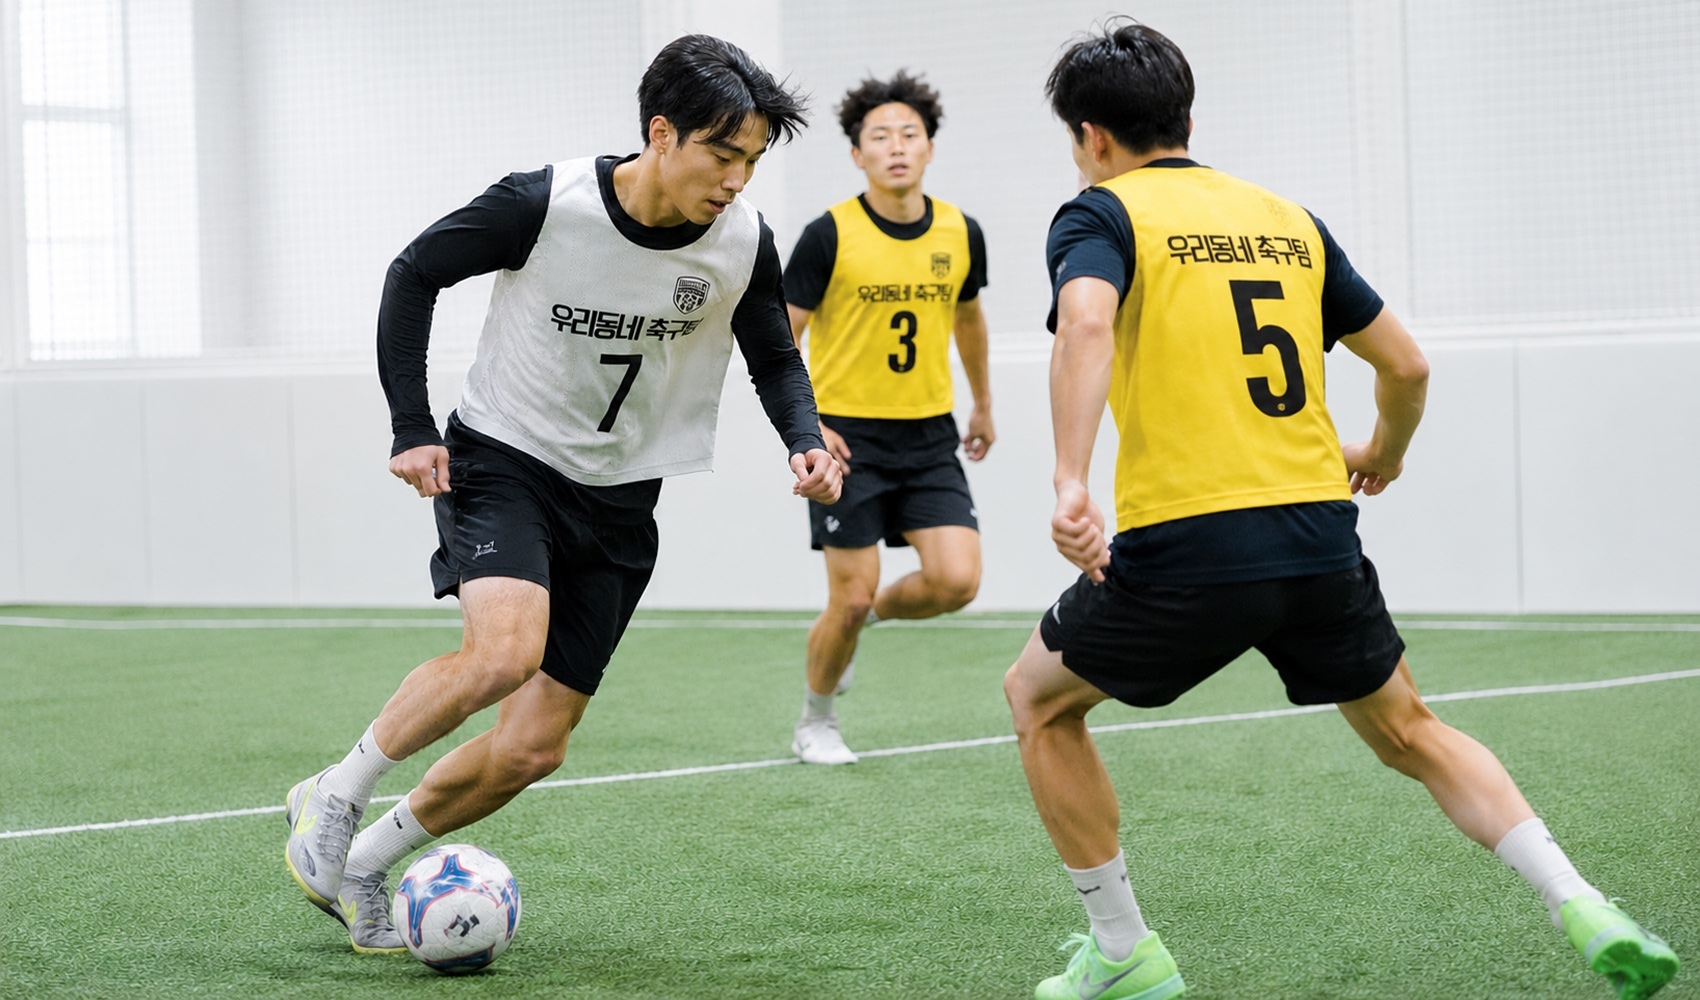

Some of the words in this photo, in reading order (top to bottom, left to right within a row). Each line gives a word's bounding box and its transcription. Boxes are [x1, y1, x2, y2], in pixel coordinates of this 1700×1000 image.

[1167, 234, 1257, 265] 우리동네
[1255, 235, 1313, 269] 축구팀
[858, 284, 912, 303] 우리동네
[915, 284, 954, 303] 축구팀
[551, 303, 646, 341] 우리동네
[888, 310, 918, 374] 3
[1229, 279, 1307, 418] 5
[597, 353, 643, 433] 7
